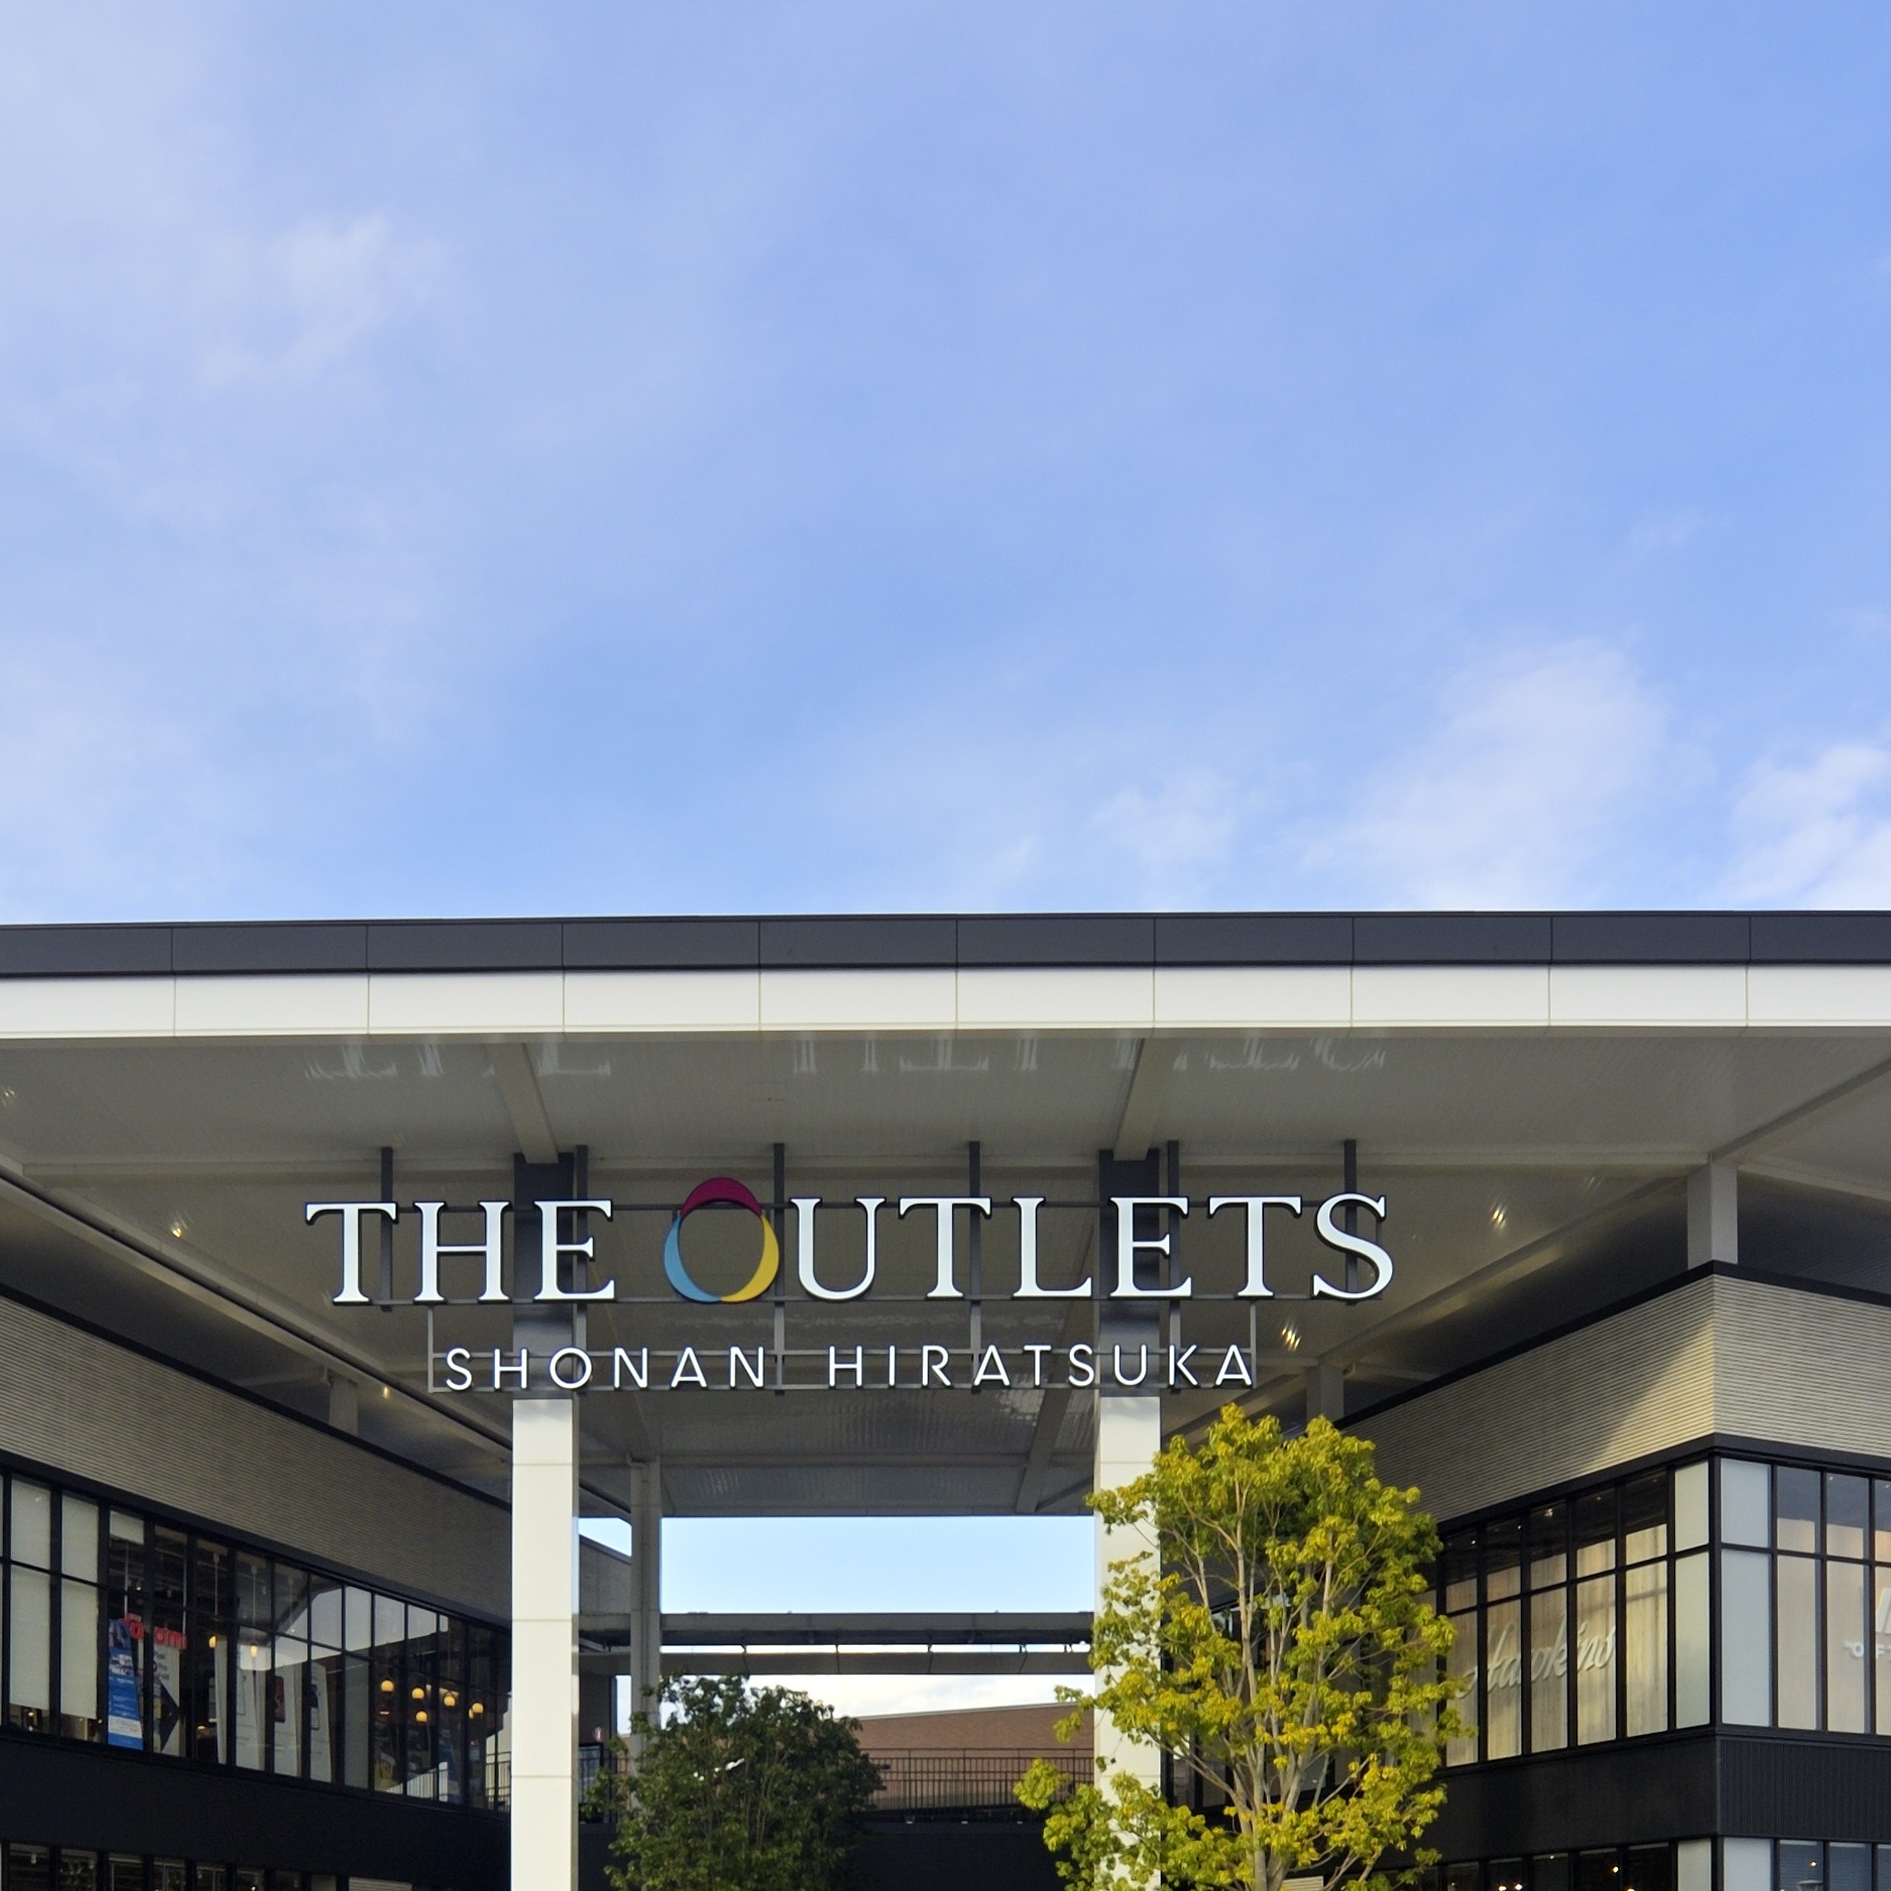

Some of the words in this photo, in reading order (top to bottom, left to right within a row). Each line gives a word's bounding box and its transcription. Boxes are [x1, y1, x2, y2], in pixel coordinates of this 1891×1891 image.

[304, 1200, 615, 1304] THE
[664, 1177, 1396, 1303] OUTLETS
[446, 1344, 767, 1392] SHONAN
[828, 1342, 1255, 1390] HIRATSUKA
